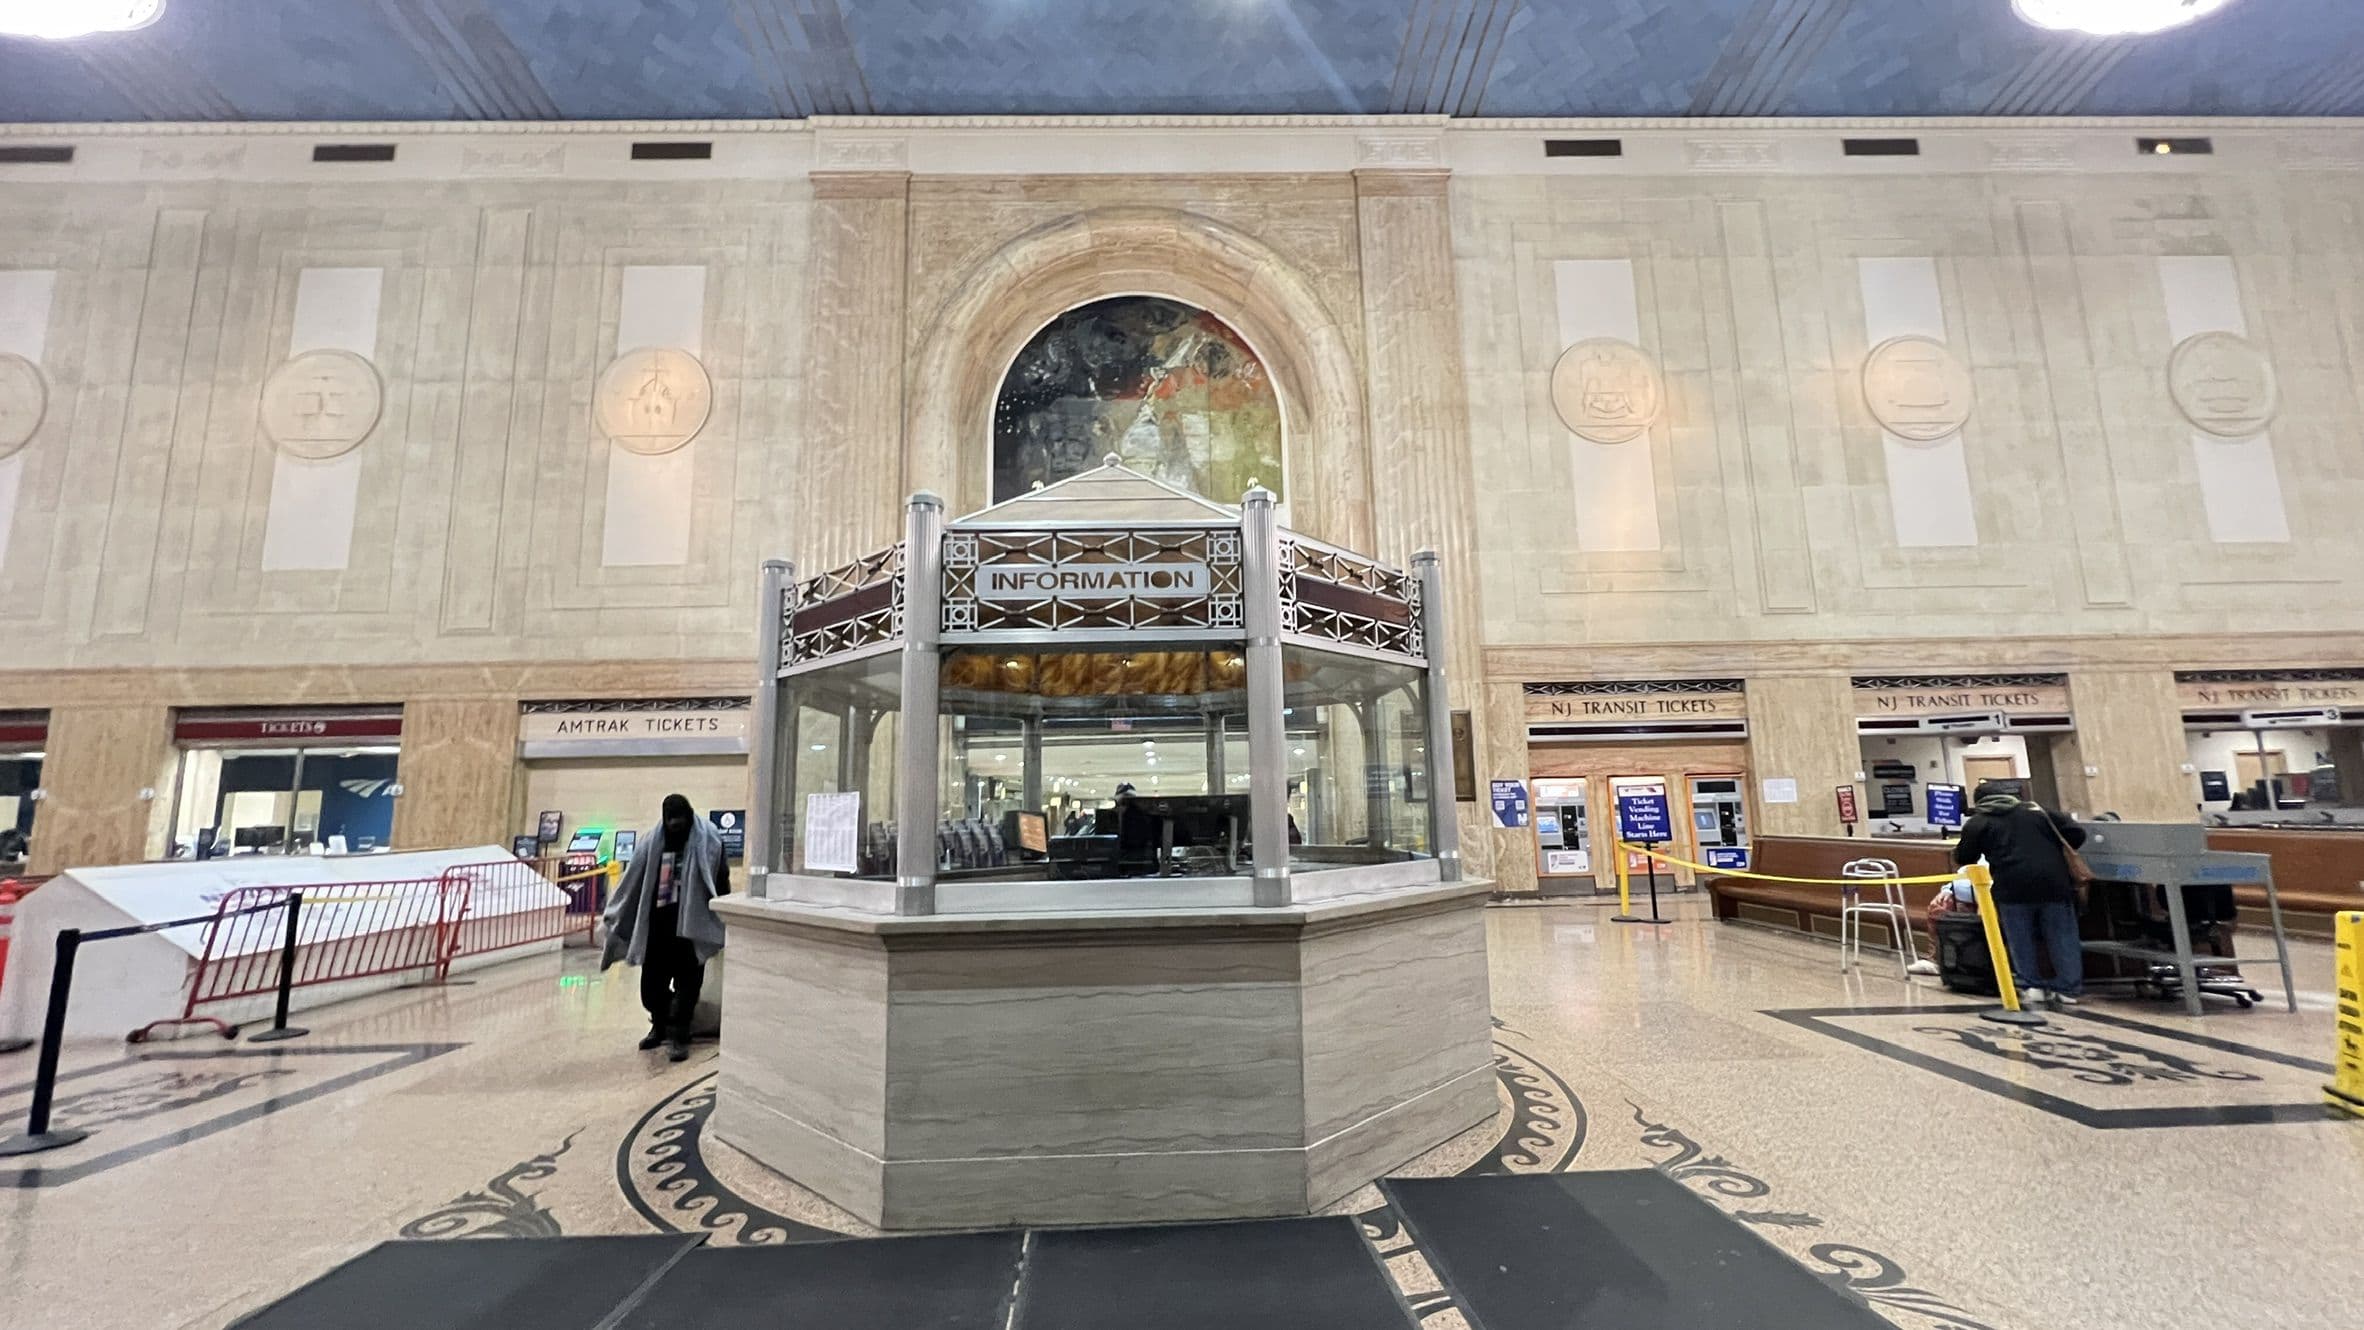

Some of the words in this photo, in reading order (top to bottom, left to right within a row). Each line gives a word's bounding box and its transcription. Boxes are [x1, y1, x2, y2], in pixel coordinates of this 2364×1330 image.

[991, 570, 1194, 590] INFORMATION
[2228, 688, 2289, 701] TRANSIT
[2299, 687, 2357, 700] TICKETS
[1551, 701, 1572, 717] NJ
[1582, 700, 1647, 714] TRANSIT
[1657, 699, 1716, 713] TICKETS
[1877, 696, 1897, 711] NJ
[1906, 694, 1971, 707] TRANSIT
[1980, 693, 2039, 706] TICKETS
[1994, 714, 2001, 725] 1
[2326, 708, 2338, 720] 3
[260, 721, 314, 734] TICKETS
[557, 719, 630, 733] AMTRAK
[646, 718, 719, 732] TICKETS
[1631, 797, 1655, 805] Ticket
[1628, 806, 1660, 814] Vending
[1629, 814, 1661, 822] Machine
[1637, 822, 1655, 830] Line
[1649, 830, 1668, 838] Here
